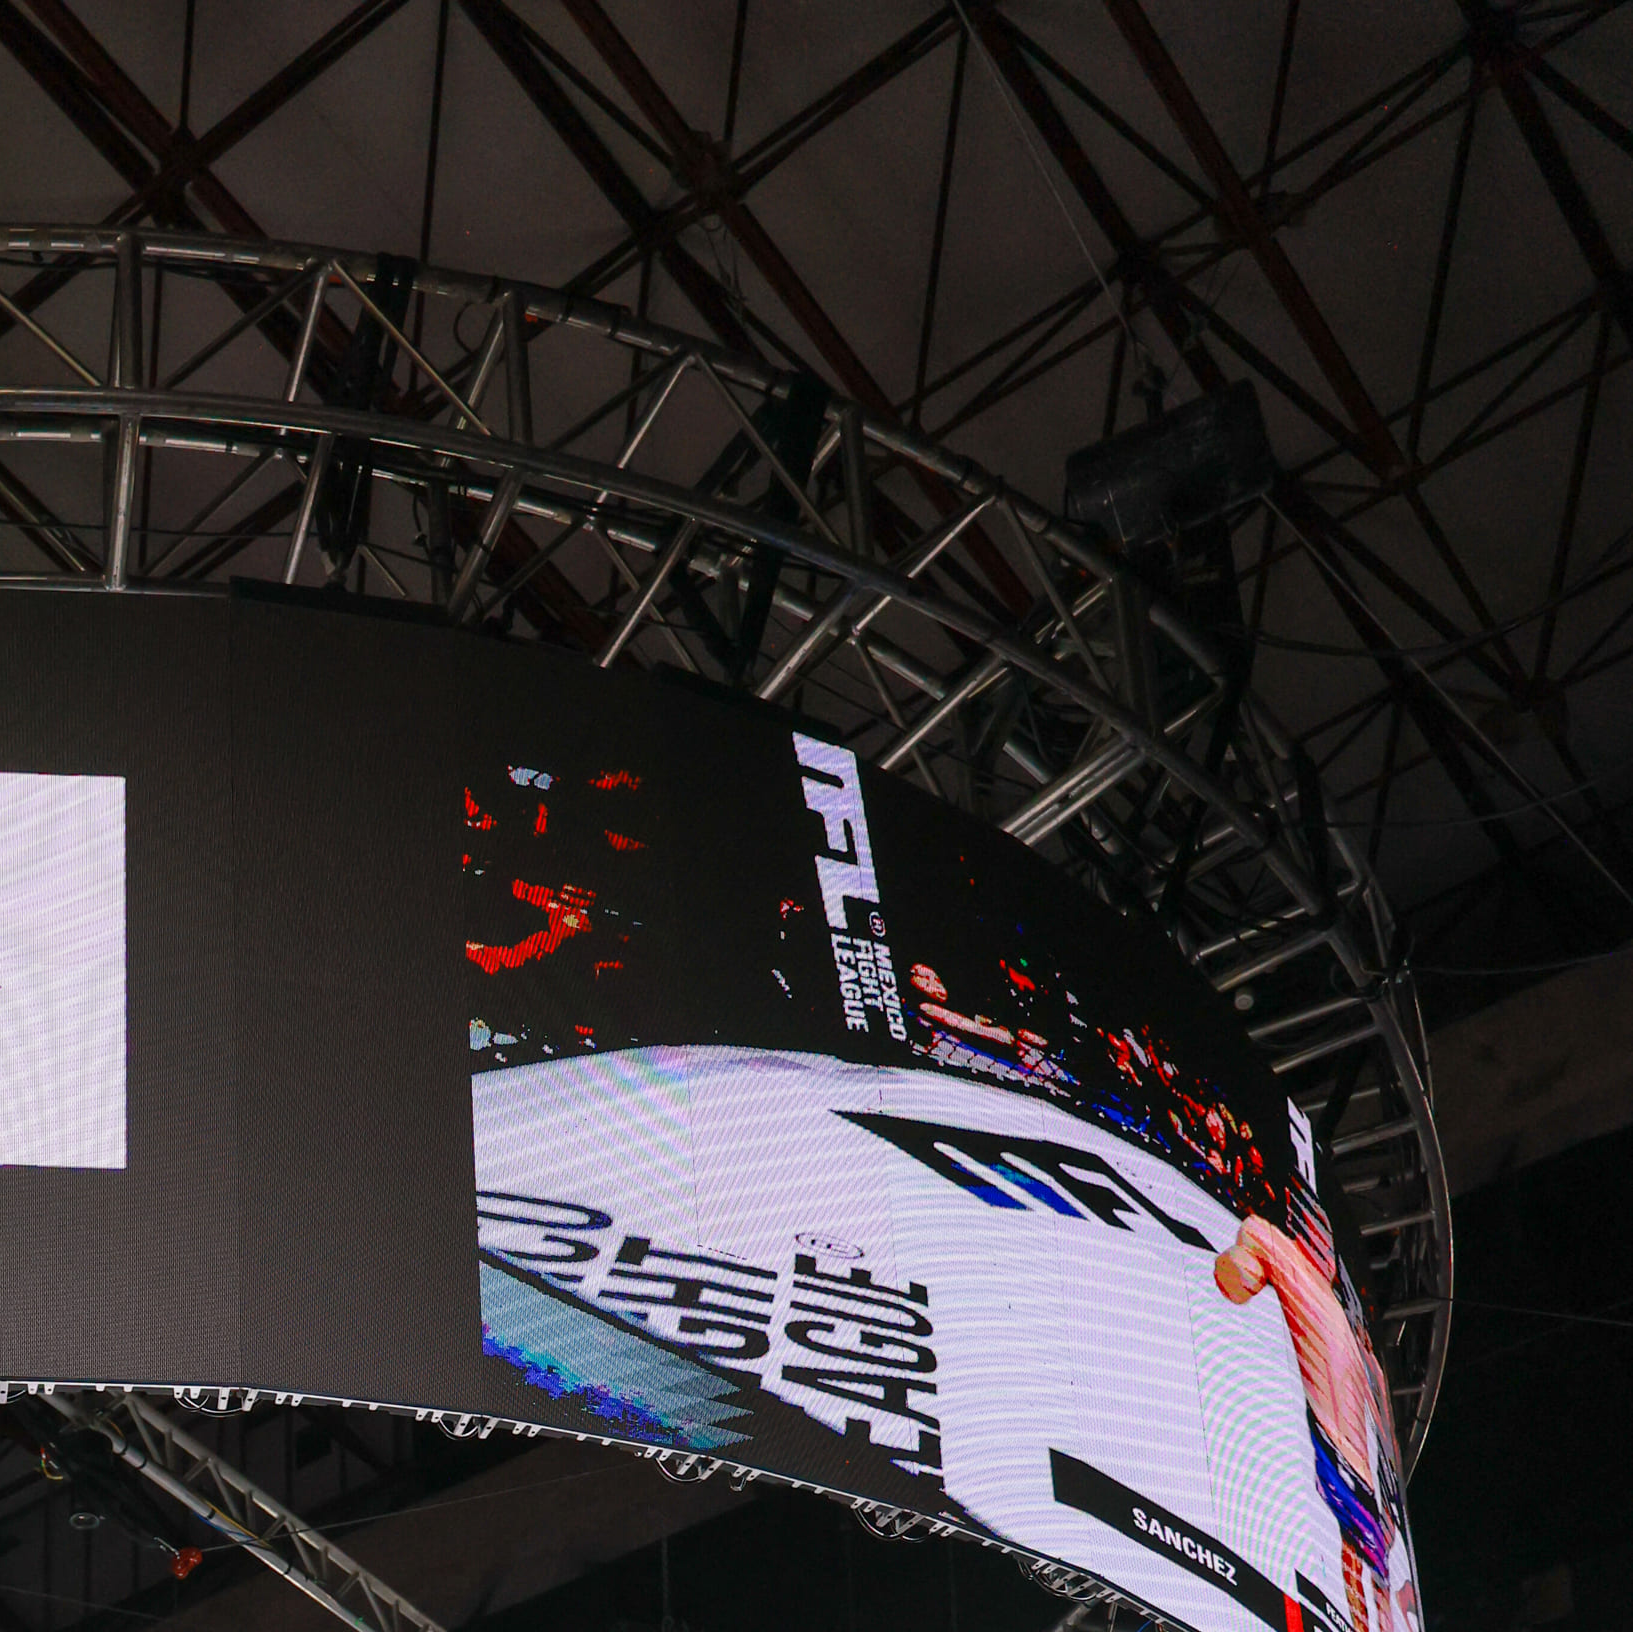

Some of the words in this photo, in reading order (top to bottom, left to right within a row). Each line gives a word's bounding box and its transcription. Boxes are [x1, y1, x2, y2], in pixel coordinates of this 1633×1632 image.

[831, 932, 869, 1033] LEAGUE
[853, 937, 885, 1013] FIGHT
[873, 941, 907, 1042] MEXICO
[1132, 1506, 1238, 1586] SANCHEZ
